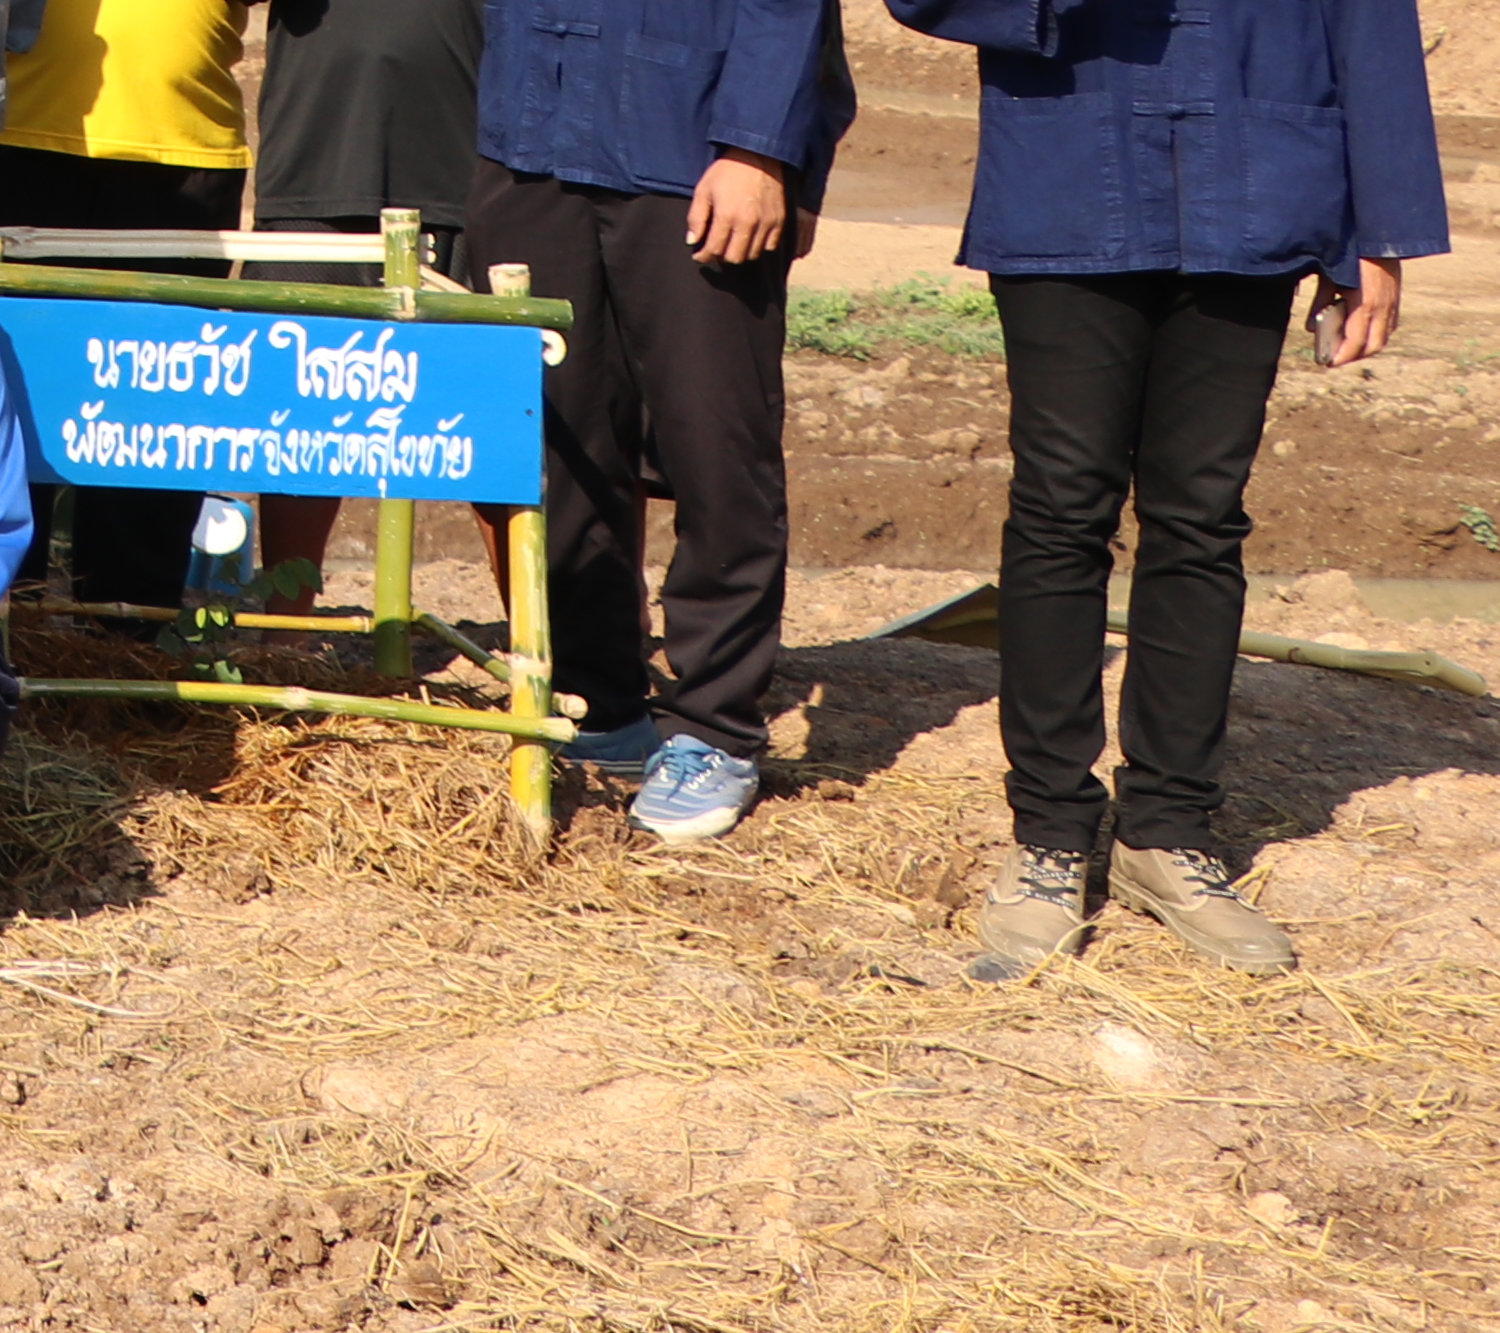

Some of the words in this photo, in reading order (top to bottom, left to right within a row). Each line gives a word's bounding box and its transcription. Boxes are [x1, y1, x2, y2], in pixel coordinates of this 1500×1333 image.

[86, 322, 258, 397] นายธวัช
[267, 320, 419, 403] ใสสม
[61, 400, 474, 499] พัฒนาการจังหวัดสุโขทัย
